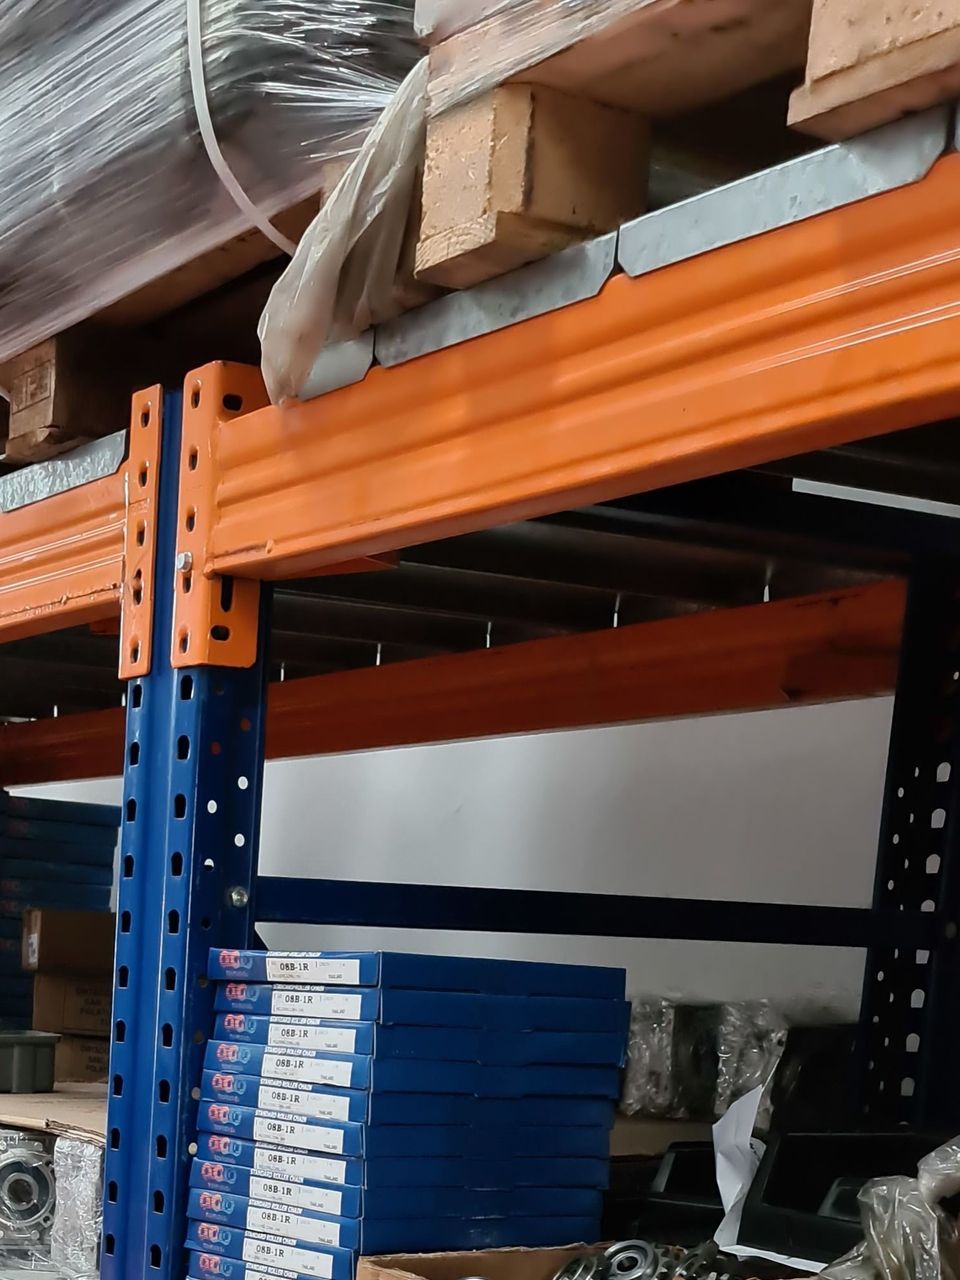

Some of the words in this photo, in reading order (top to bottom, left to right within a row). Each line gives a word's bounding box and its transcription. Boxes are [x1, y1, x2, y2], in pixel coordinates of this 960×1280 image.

[280, 962, 309, 971] 08B-1R
[281, 1029, 308, 1038] 08B-1R
[276, 1059, 304, 1068] 08B-1R
[271, 1091, 300, 1103] 08B-1R
[267, 1122, 295, 1134] 08B-1R
[268, 1154, 296, 1165] 08B-1R
[263, 1184, 292, 1196] 08B-1R
[261, 1212, 291, 1224] 08B-1R
[256, 1245, 284, 1257] 08B-1R
